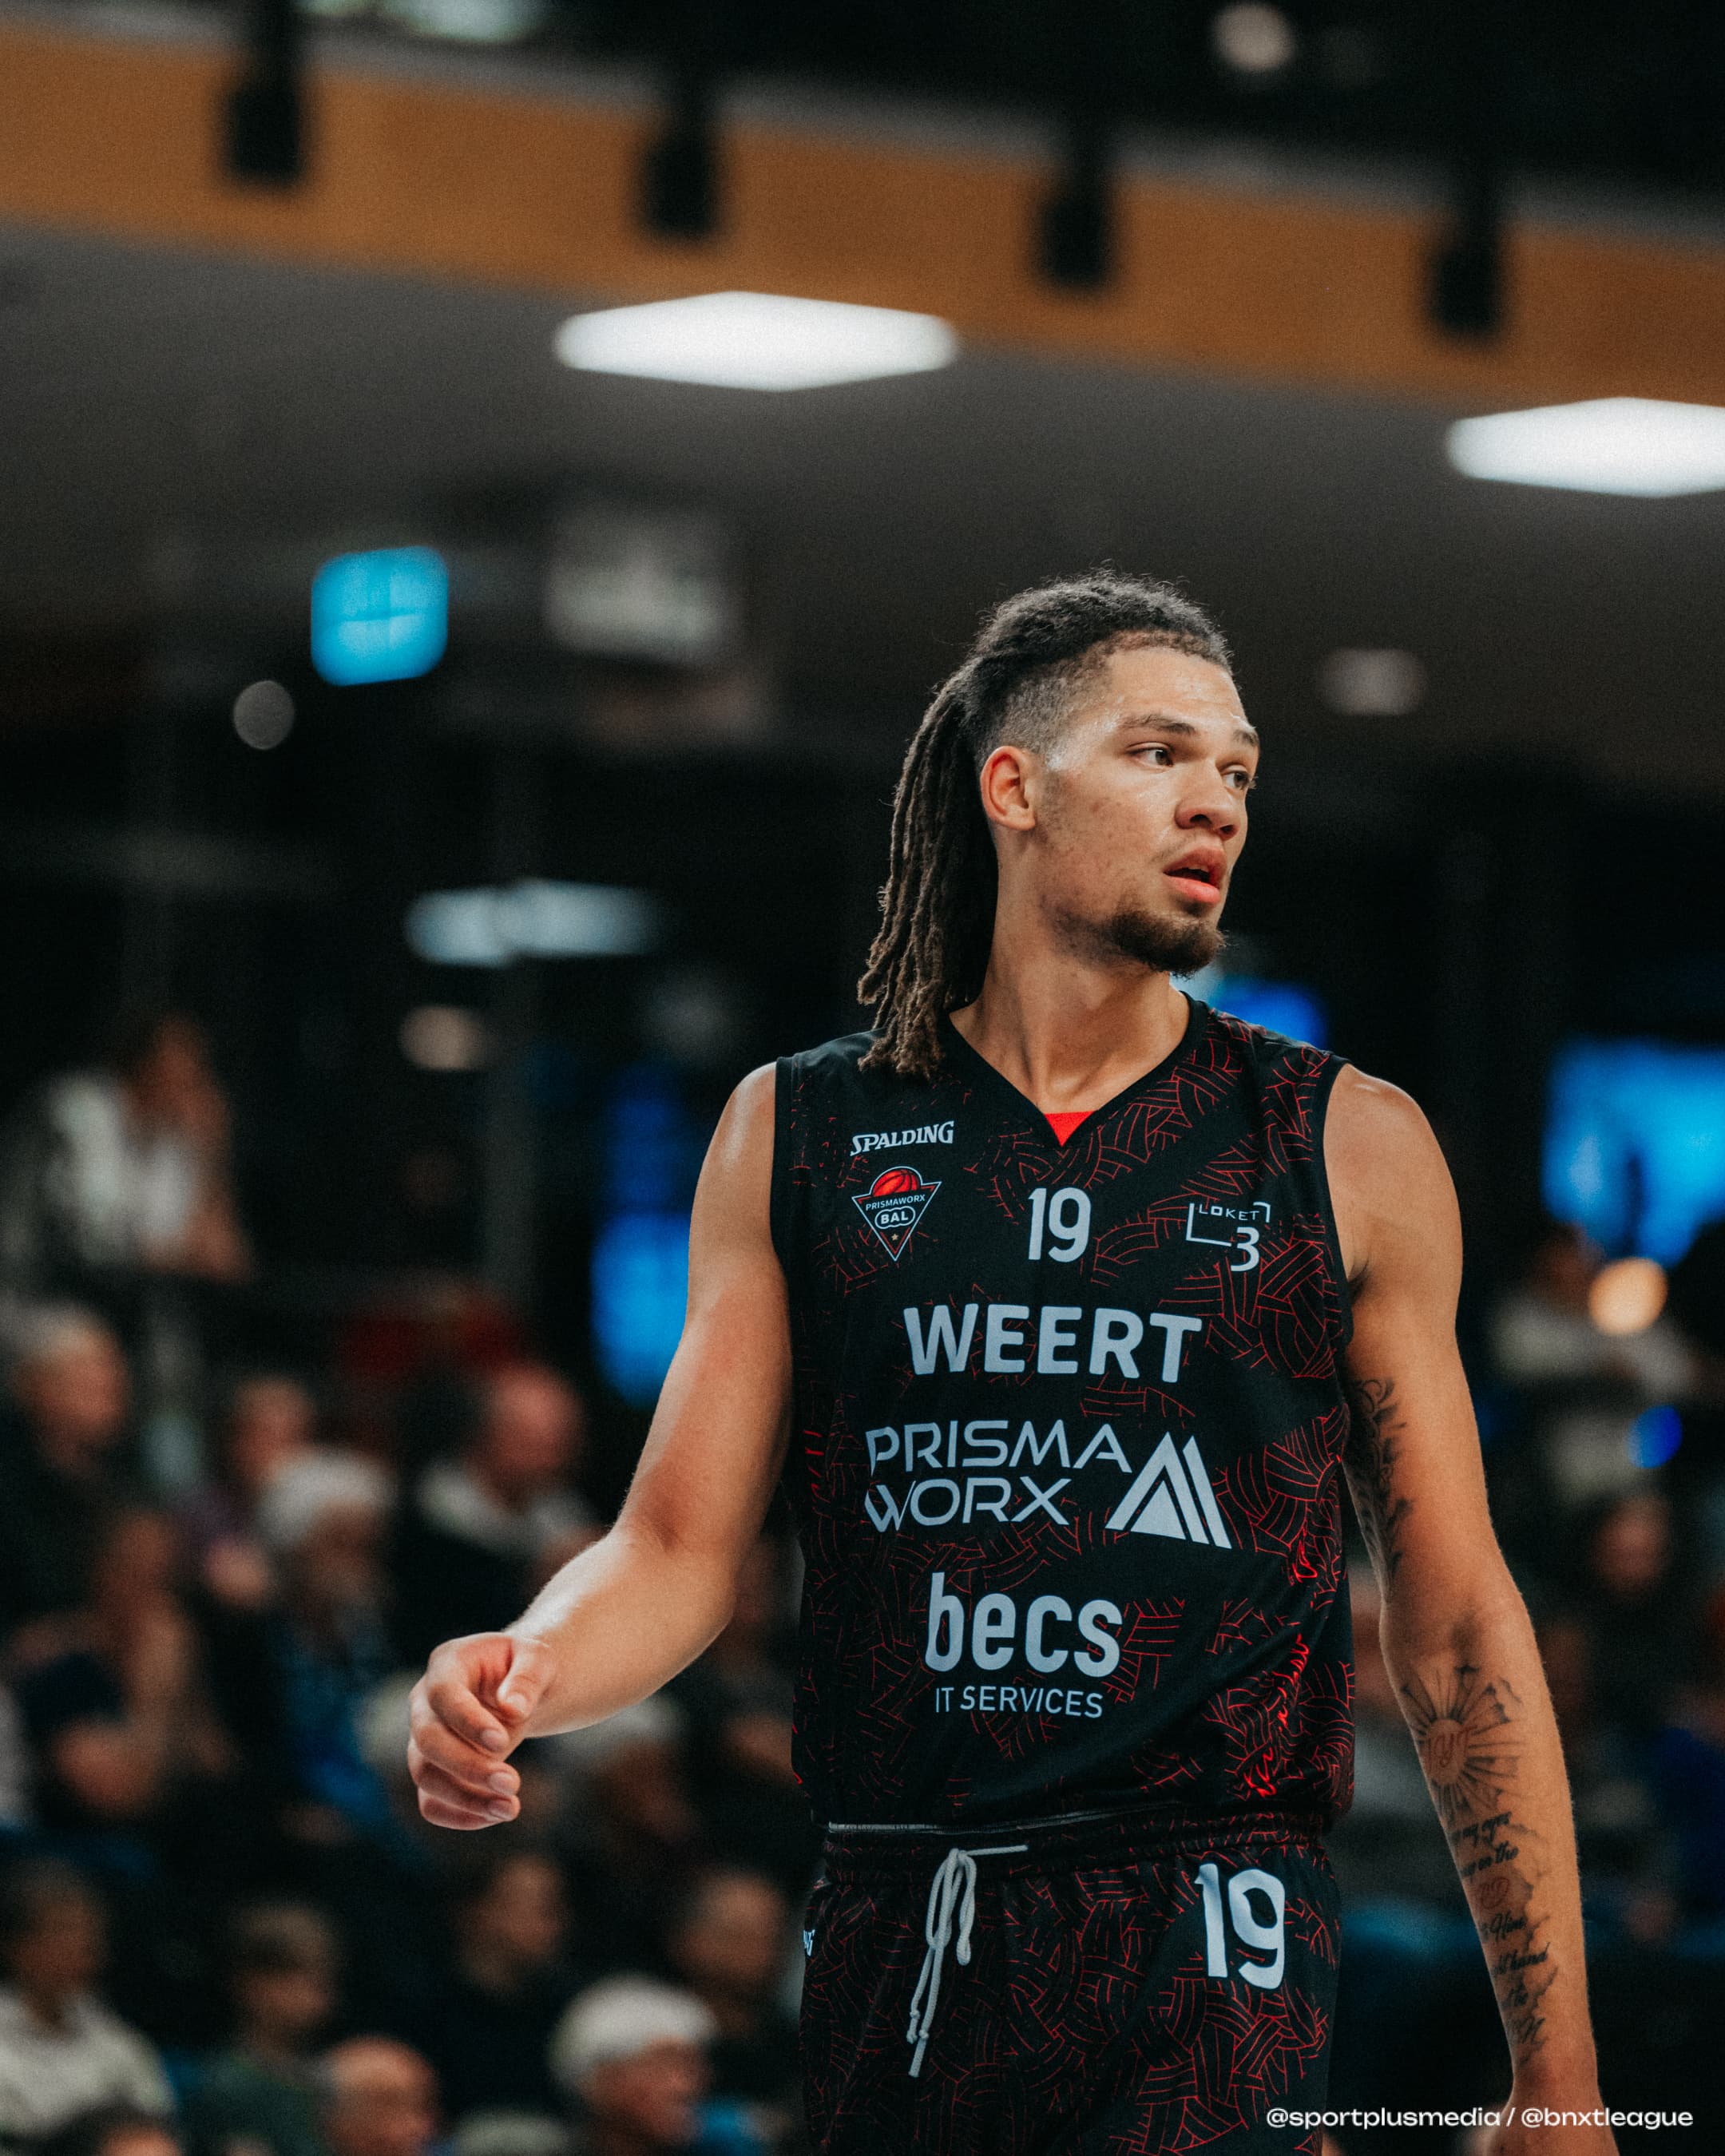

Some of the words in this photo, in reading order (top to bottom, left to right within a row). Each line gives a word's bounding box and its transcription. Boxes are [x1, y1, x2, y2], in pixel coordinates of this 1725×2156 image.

[850, 1120, 954, 1156] SPALDING
[865, 1194, 926, 1211] PRISMAWORX
[881, 1211, 909, 1225] BAL
[1028, 1187, 1091, 1262] 19
[1199, 1203, 1260, 1221] LOKET
[1230, 1227, 1259, 1272] 3
[903, 1303, 1203, 1383] WEERT
[866, 1419, 1132, 1476] PRISMA
[865, 1476, 1071, 1532] WORX
[925, 1571, 1123, 1678] becs
[936, 1687, 953, 1713] IT
[961, 1686, 1103, 1718] SERVICES
[1194, 1863, 1286, 1989] 19
